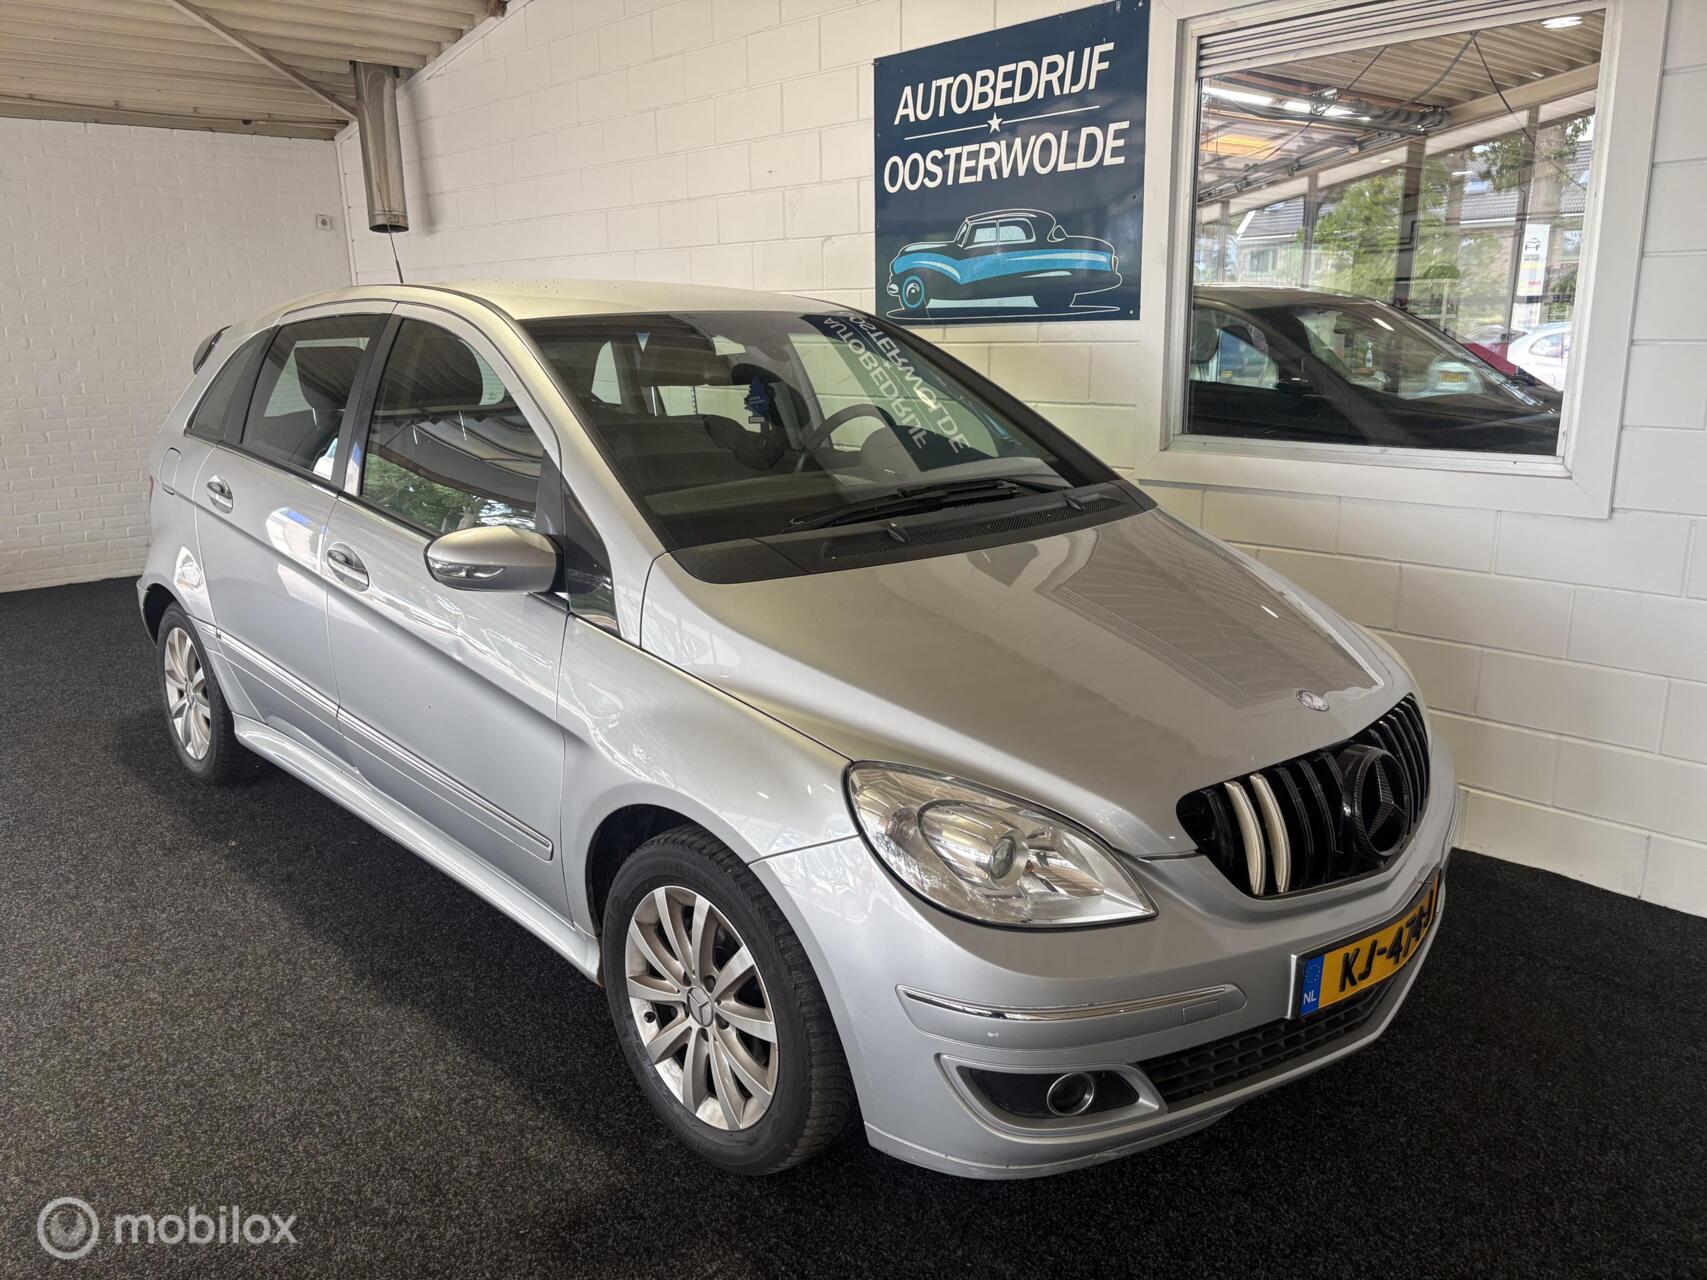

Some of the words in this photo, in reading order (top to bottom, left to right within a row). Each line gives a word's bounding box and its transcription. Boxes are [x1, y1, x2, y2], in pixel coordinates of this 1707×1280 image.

[893, 42, 1115, 125] AUTOBEDRIJF
[884, 121, 1130, 193] OOSTERWOLDE
[1303, 990, 1317, 1005] NL
